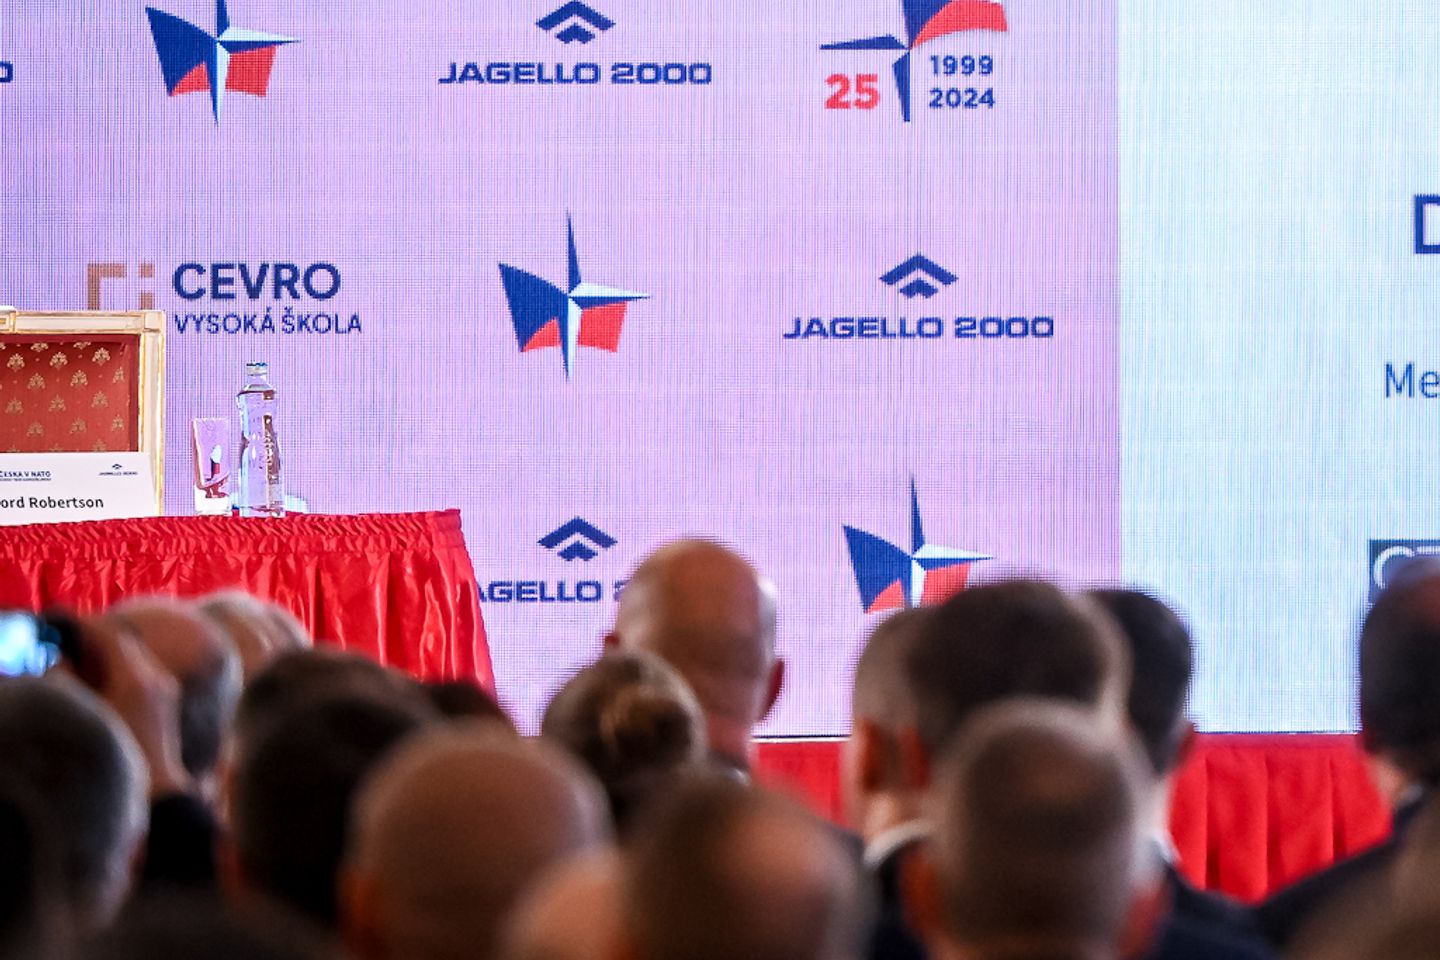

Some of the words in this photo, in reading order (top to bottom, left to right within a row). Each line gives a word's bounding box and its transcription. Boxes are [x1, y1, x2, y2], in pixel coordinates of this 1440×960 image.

[438, 62, 601, 85] JAGELLO
[610, 62, 712, 85] 2000
[930, 54, 994, 76] 1999
[824, 74, 881, 110] 25
[928, 87, 996, 109] 2024
[172, 262, 341, 301] CEVRO
[173, 306, 275, 335] VYSOKÁ
[281, 306, 362, 335] ŠKOLA
[783, 316, 944, 340] JAGELLO
[954, 316, 1055, 339] 2000
[0, 496, 25, 509] ord
[29, 496, 104, 509] Robertson
